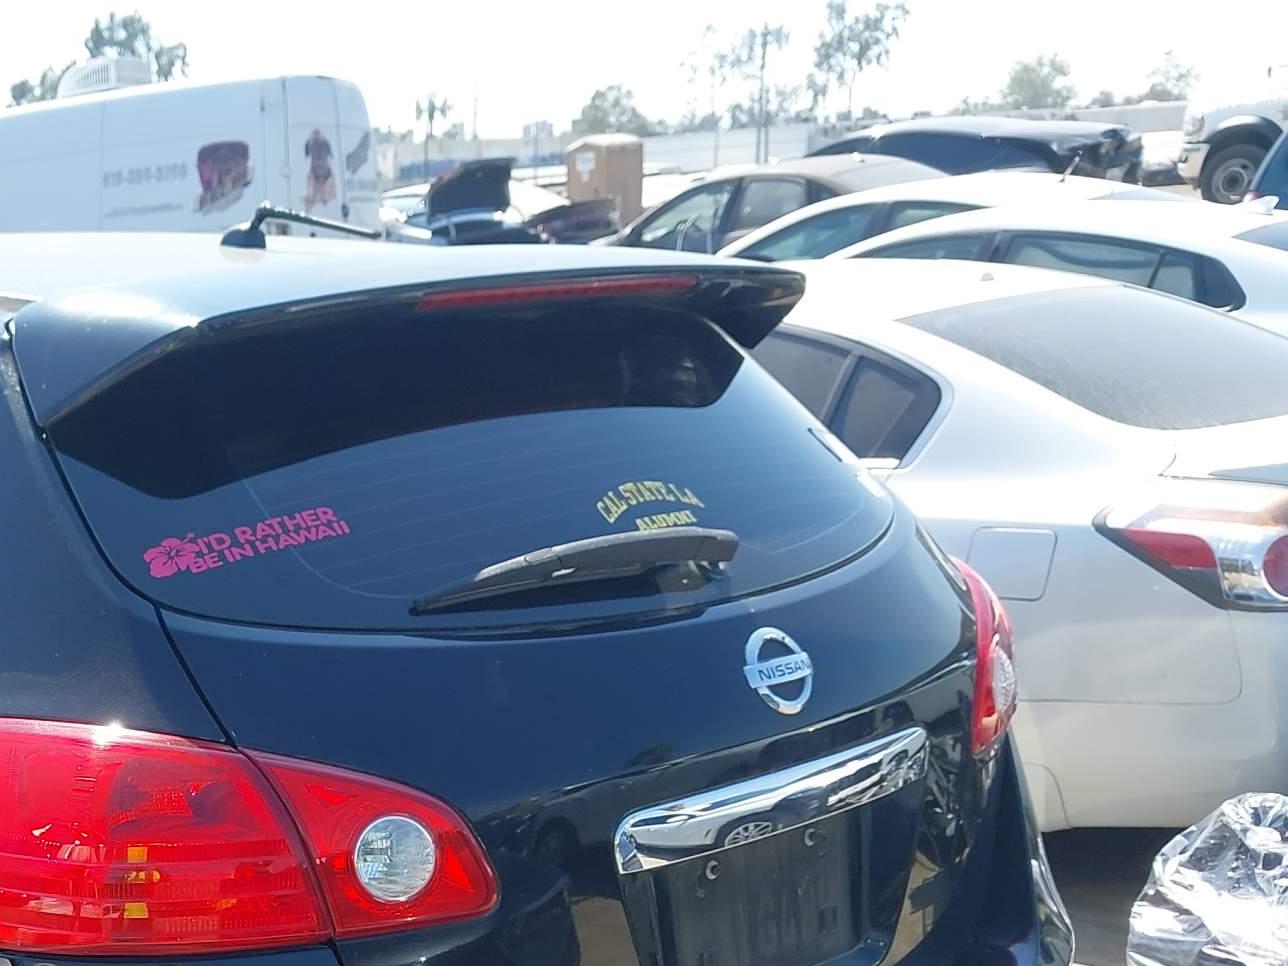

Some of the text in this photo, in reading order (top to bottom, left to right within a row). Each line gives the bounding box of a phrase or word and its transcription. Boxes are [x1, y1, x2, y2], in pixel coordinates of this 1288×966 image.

[596, 480, 705, 524] CAL STATE LA
[635, 509, 697, 534] ALUMNI
[191, 520, 351, 574] BE IN HAWAII
[196, 506, 337, 554] I'D RATHER
[757, 659, 811, 681] NISSAN
